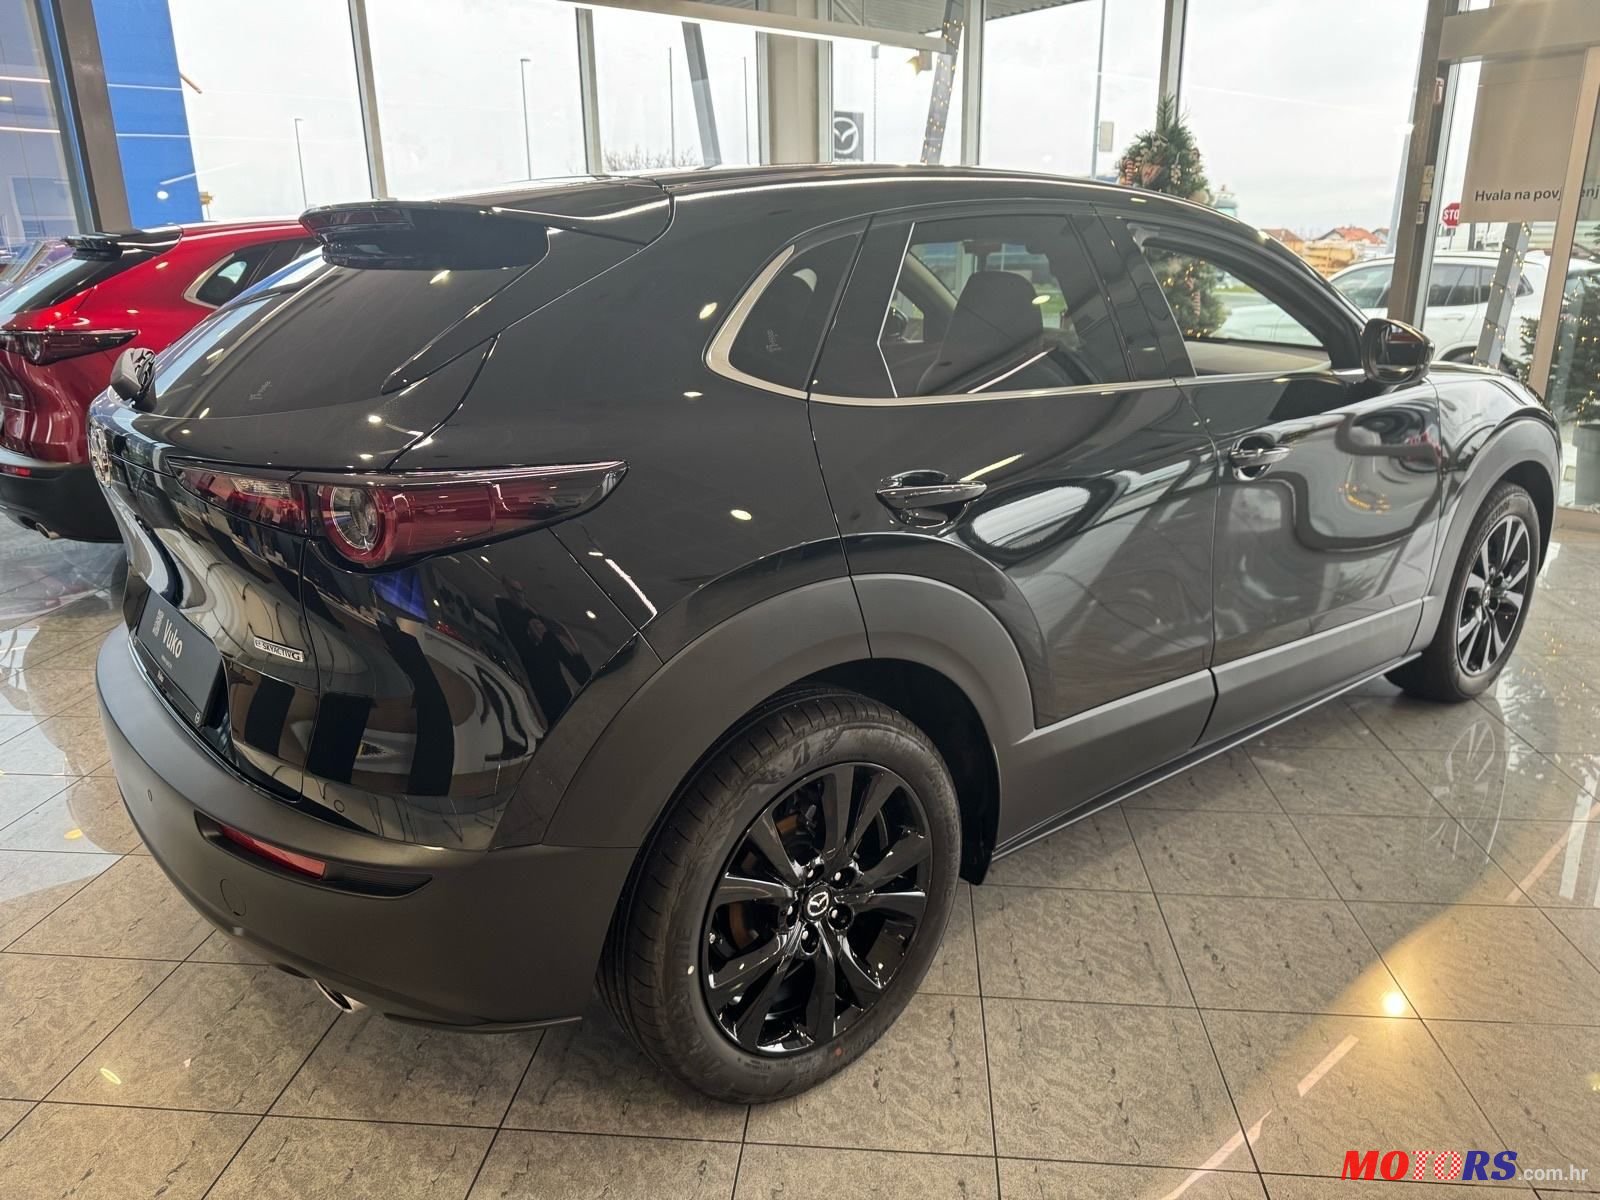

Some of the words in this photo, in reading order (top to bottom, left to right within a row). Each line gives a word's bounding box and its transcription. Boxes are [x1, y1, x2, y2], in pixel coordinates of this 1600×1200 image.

[1475, 189, 1511, 202] Hvala
[1514, 191, 1531, 200] na
[1443, 208, 1460, 220] STO
[162, 618, 184, 659] Vuko
